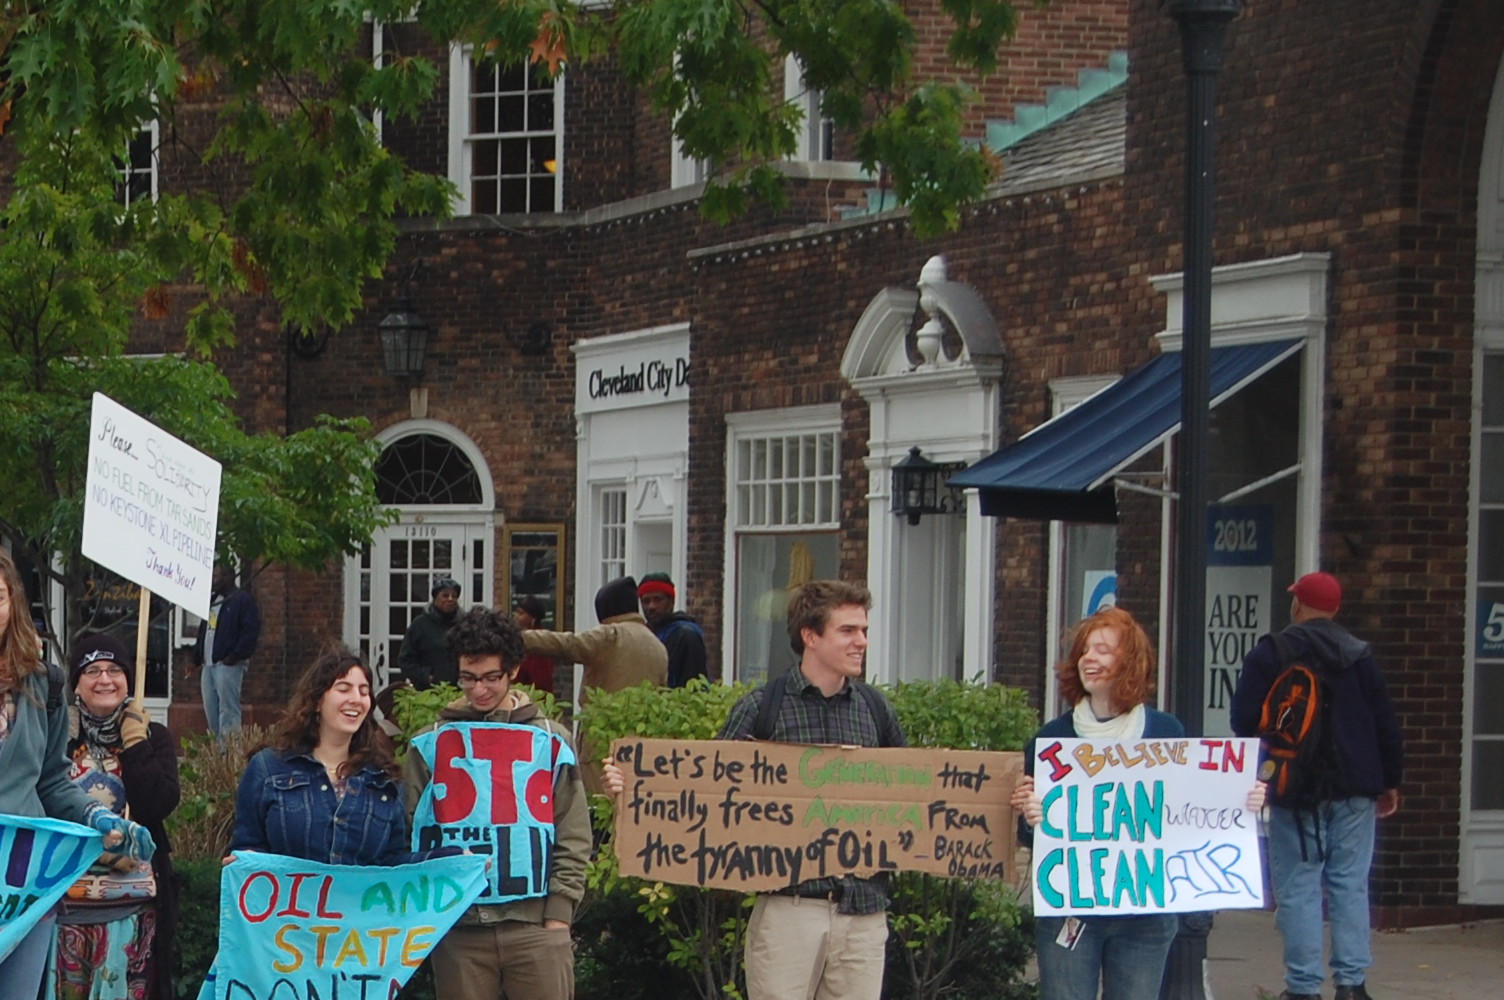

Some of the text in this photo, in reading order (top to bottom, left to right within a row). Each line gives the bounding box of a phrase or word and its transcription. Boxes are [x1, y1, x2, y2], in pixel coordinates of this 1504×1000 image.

[589, 362, 644, 398] Cleveland
[647, 360, 673, 397] City
[94, 456, 109, 479] NO
[113, 467, 134, 496] FUEL
[138, 481, 163, 512] FROM
[93, 484, 213, 569] NO KEYSTONE XL PIPELINE
[1214, 519, 1257, 551] 2012
[146, 547, 196, 591] Thank You!
[1208, 594, 1258, 629] ARE
[1208, 631, 1255, 665] YOU
[713, 750, 744, 783] be
[750, 750, 788, 785] the
[937, 761, 991, 793] that
[1038, 740, 1245, 783] I BELIEVE IN
[628, 780, 708, 833] finally
[719, 786, 794, 829] frees
[1040, 780, 1246, 842] CLEAN WATER
[443, 826, 492, 842] THE
[636, 831, 688, 874] the
[806, 828, 839, 877] of
[239, 871, 465, 923] OIL AND
[1037, 840, 1260, 908] CLEAN AIR
[273, 924, 437, 973] STATE
